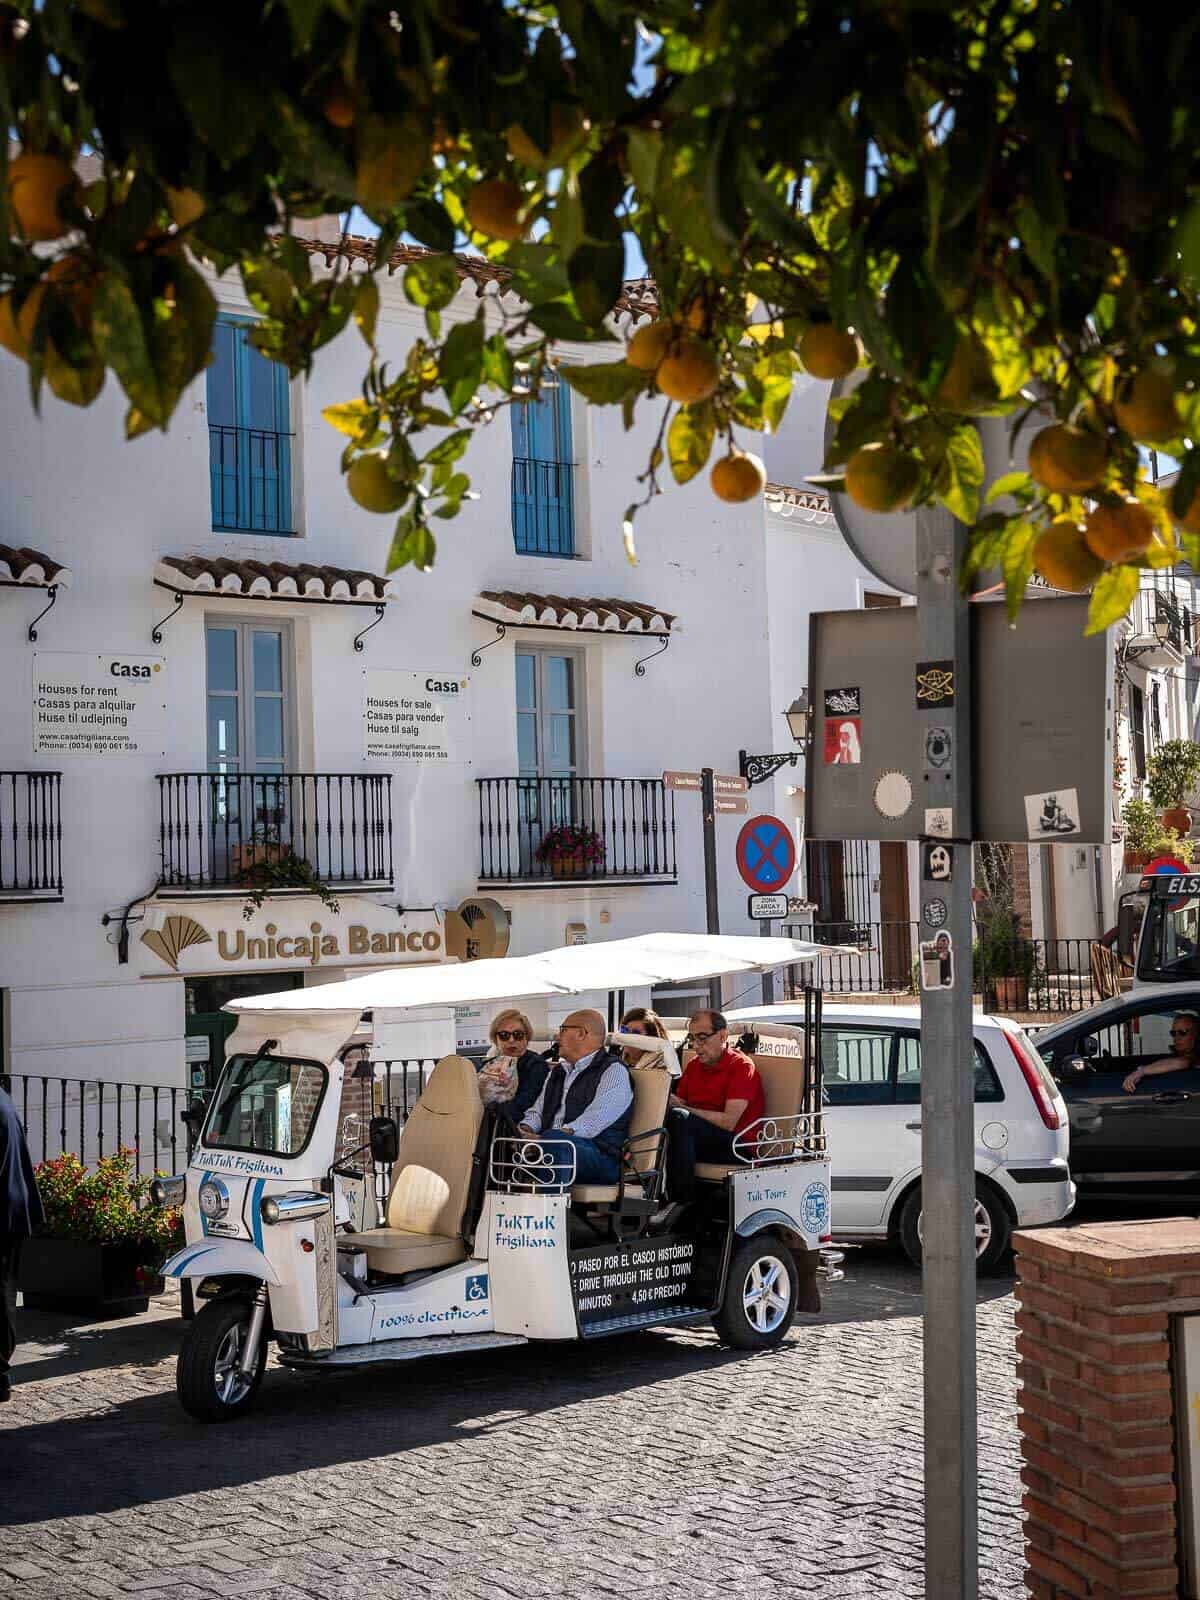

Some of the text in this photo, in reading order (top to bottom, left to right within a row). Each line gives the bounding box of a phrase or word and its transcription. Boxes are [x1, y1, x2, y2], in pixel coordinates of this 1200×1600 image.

[110, 662, 151, 677] Casa
[38, 683, 118, 696] Houses for rent
[425, 678, 459, 693] Casa
[38, 697, 136, 712] Casas para alquilar
[367, 697, 432, 709] Houses for sale
[38, 712, 128, 727] Huse til udlejning
[367, 710, 445, 722] Casas para vender
[367, 723, 389, 733] Huse
[391, 724, 400, 734] til
[217, 921, 441, 965] Unicaja Banco
[235, 1157, 283, 1175] Frigiliana
[495, 1232, 556, 1250] Frigiliana
[578, 1258, 602, 1273] PASEO
[604, 1255, 619, 1270] POR
[621, 1254, 630, 1267] EL
[632, 1250, 656, 1265] CASCO
[658, 1243, 693, 1261] HISTÓRICO
[579, 1277, 601, 1291] DRIVE
[603, 1271, 637, 1288] THROUGH
[640, 1268, 653, 1282] THE
[655, 1265, 669, 1279] OLD
[671, 1262, 691, 1276] TOWN
[579, 1293, 612, 1311] MINUTOS
[654, 1284, 681, 1300] PRECIO
